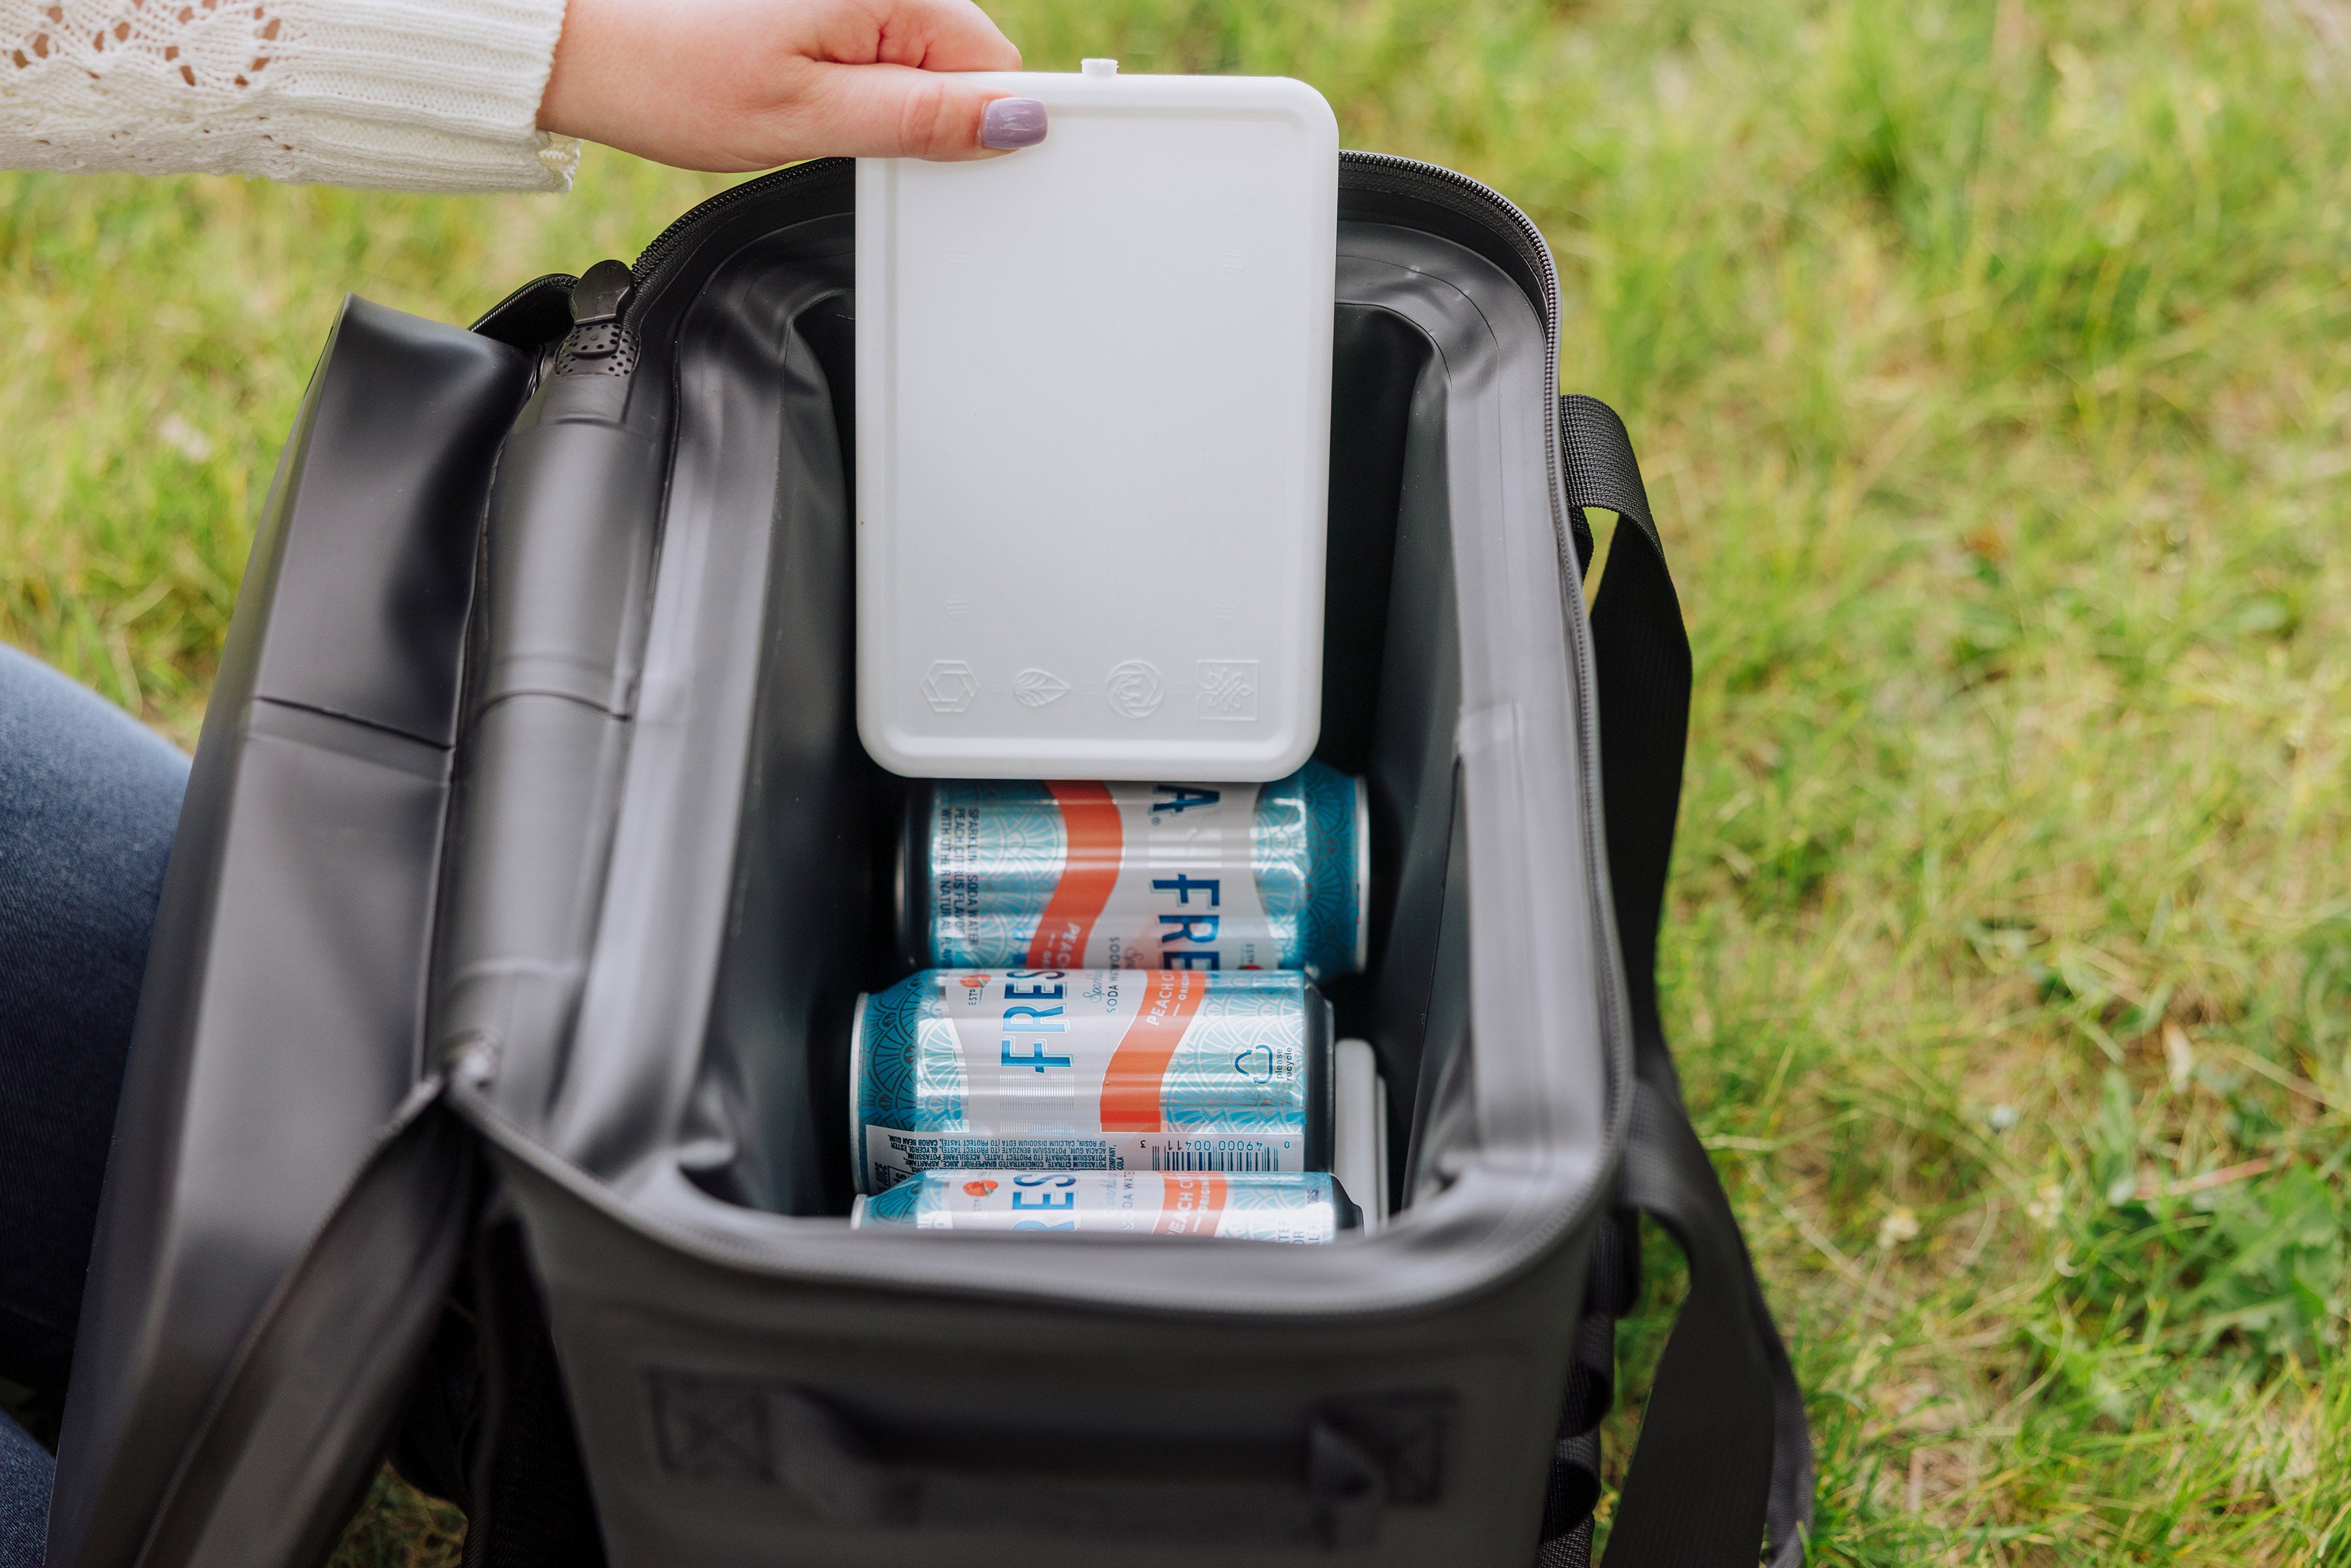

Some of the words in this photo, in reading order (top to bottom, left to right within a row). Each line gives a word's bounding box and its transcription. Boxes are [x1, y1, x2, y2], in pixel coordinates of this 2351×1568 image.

[940, 808, 952, 835] WITH
[953, 808, 966, 842] PEACH
[940, 839, 952, 876] OTHER
[968, 875, 979, 906] SODA
[940, 880, 952, 932] NATURAL
[1107, 985, 1119, 1014] SODA
[1145, 984, 1175, 1026] PEACH
[1275, 1049, 1285, 1080] please
[1285, 1047, 1295, 1081] recycle
[887, 1134, 901, 1144] GUM.
[890, 1142, 906, 1151] ESTER
[903, 1137, 916, 1145] BEAN
[1140, 1140, 1146, 1149] 3
[1167, 1140, 1211, 1151] 00411
[1218, 1140, 1262, 1151] 49000
[1284, 1141, 1290, 1149] 0
[903, 1157, 939, 1167] ASPARTAME,
[906, 1151, 941, 1160] POTASSIUM,
